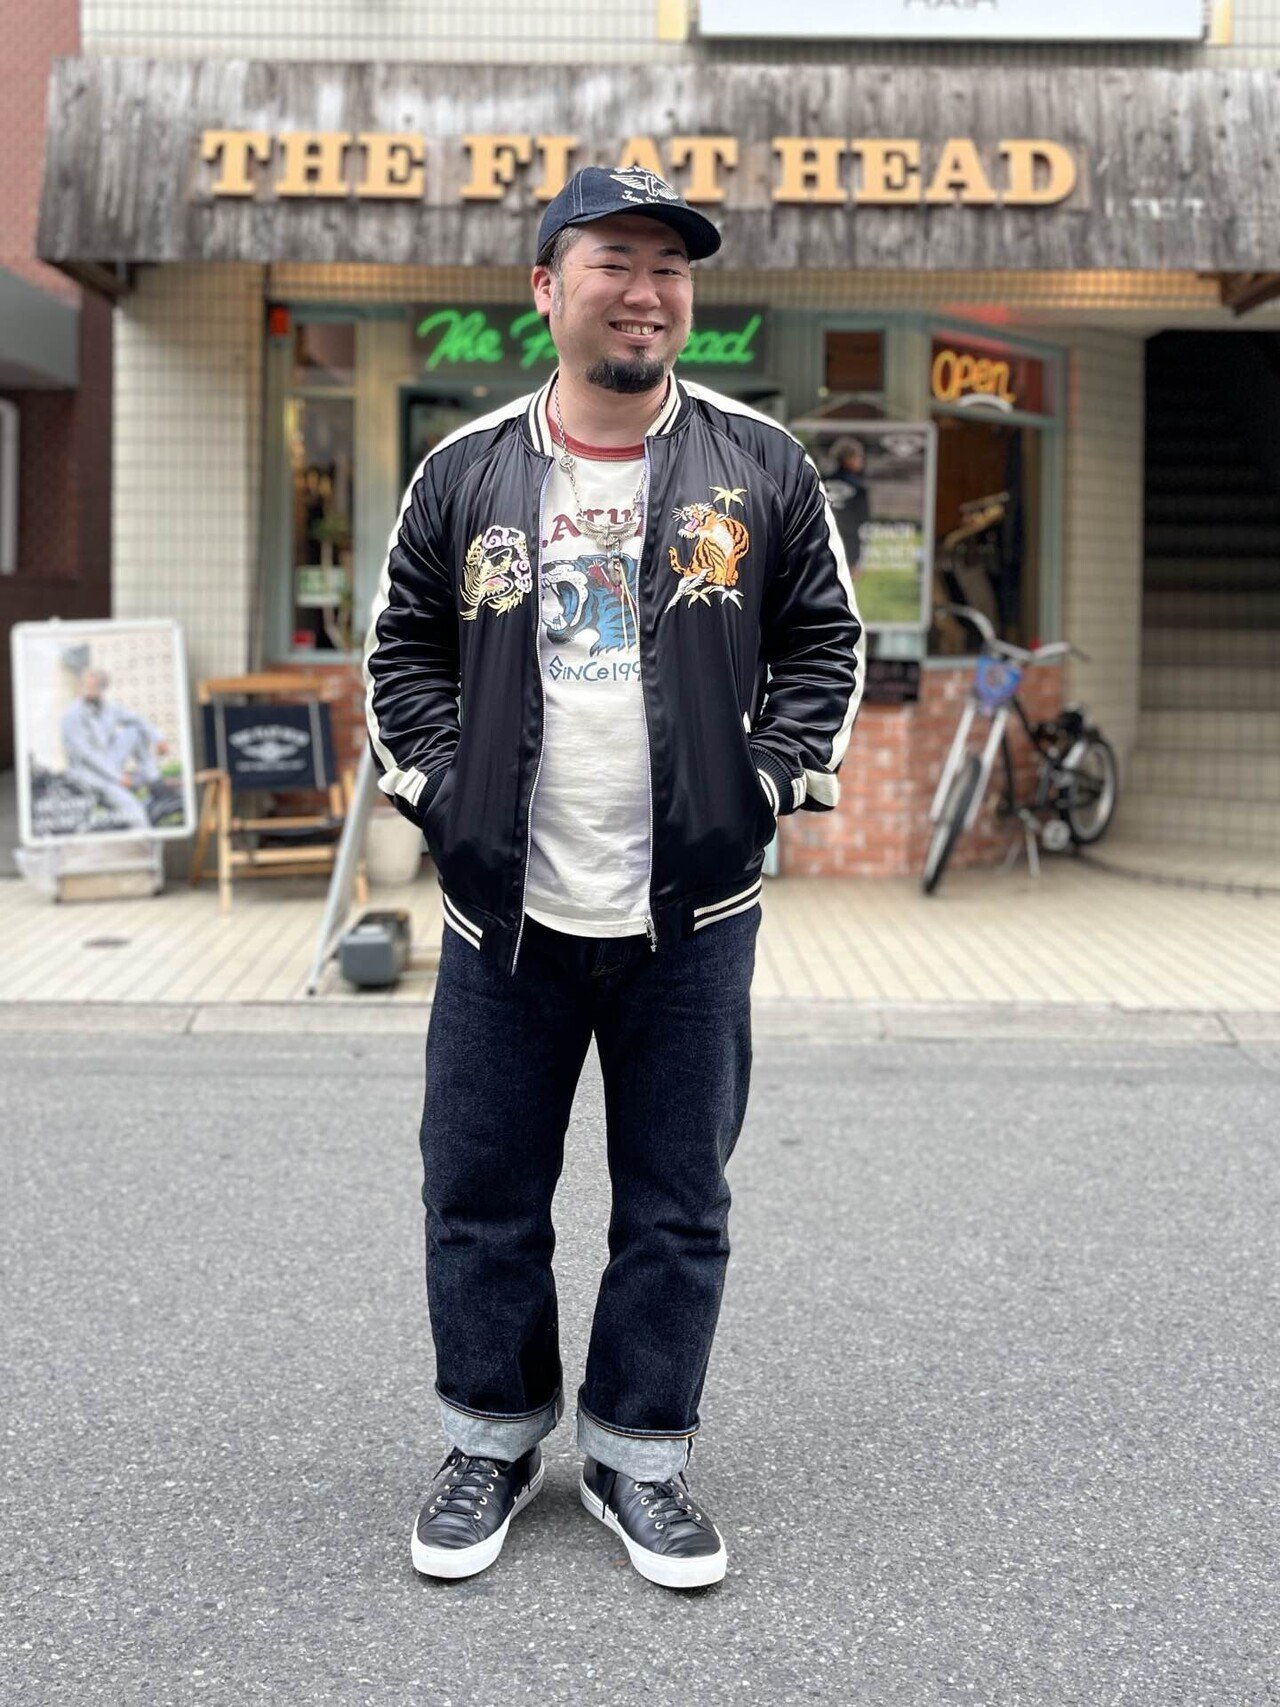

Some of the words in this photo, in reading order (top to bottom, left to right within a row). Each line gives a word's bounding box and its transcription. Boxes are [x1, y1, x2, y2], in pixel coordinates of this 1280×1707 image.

[201, 130, 426, 200] THE
[772, 137, 1079, 206] HEAD
[416, 309, 504, 372] The
[679, 314, 763, 364] ead
[931, 349, 1016, 404] Open
